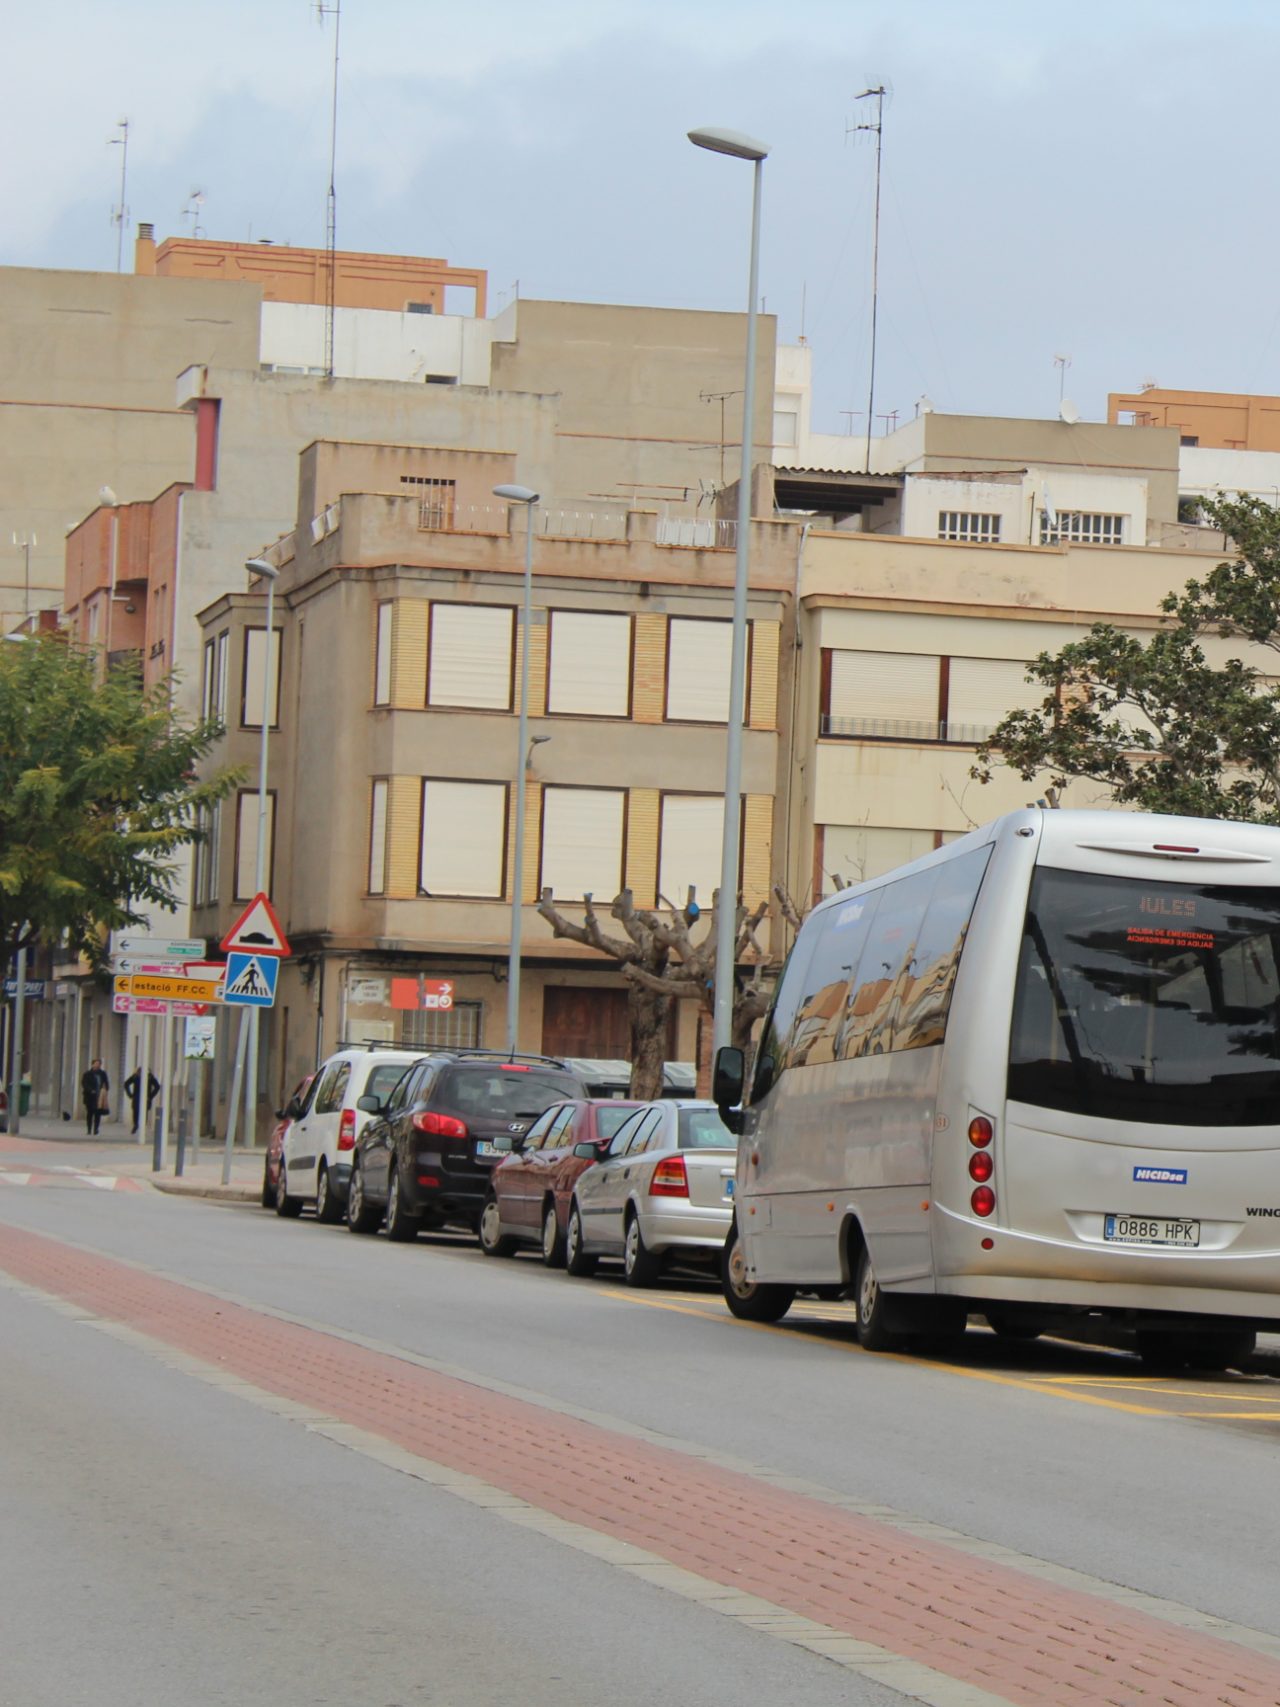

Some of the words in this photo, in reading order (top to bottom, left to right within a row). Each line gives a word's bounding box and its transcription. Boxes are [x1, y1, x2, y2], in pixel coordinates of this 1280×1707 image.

[1155, 929, 1166, 937] DE
[1167, 930, 1214, 940] EMERGENCIA
[134, 982, 171, 992] estació
[176, 985, 208, 995] FF.CC.
[1119, 1220, 1159, 1237] 0886
[1165, 1224, 1193, 1240] HPK
